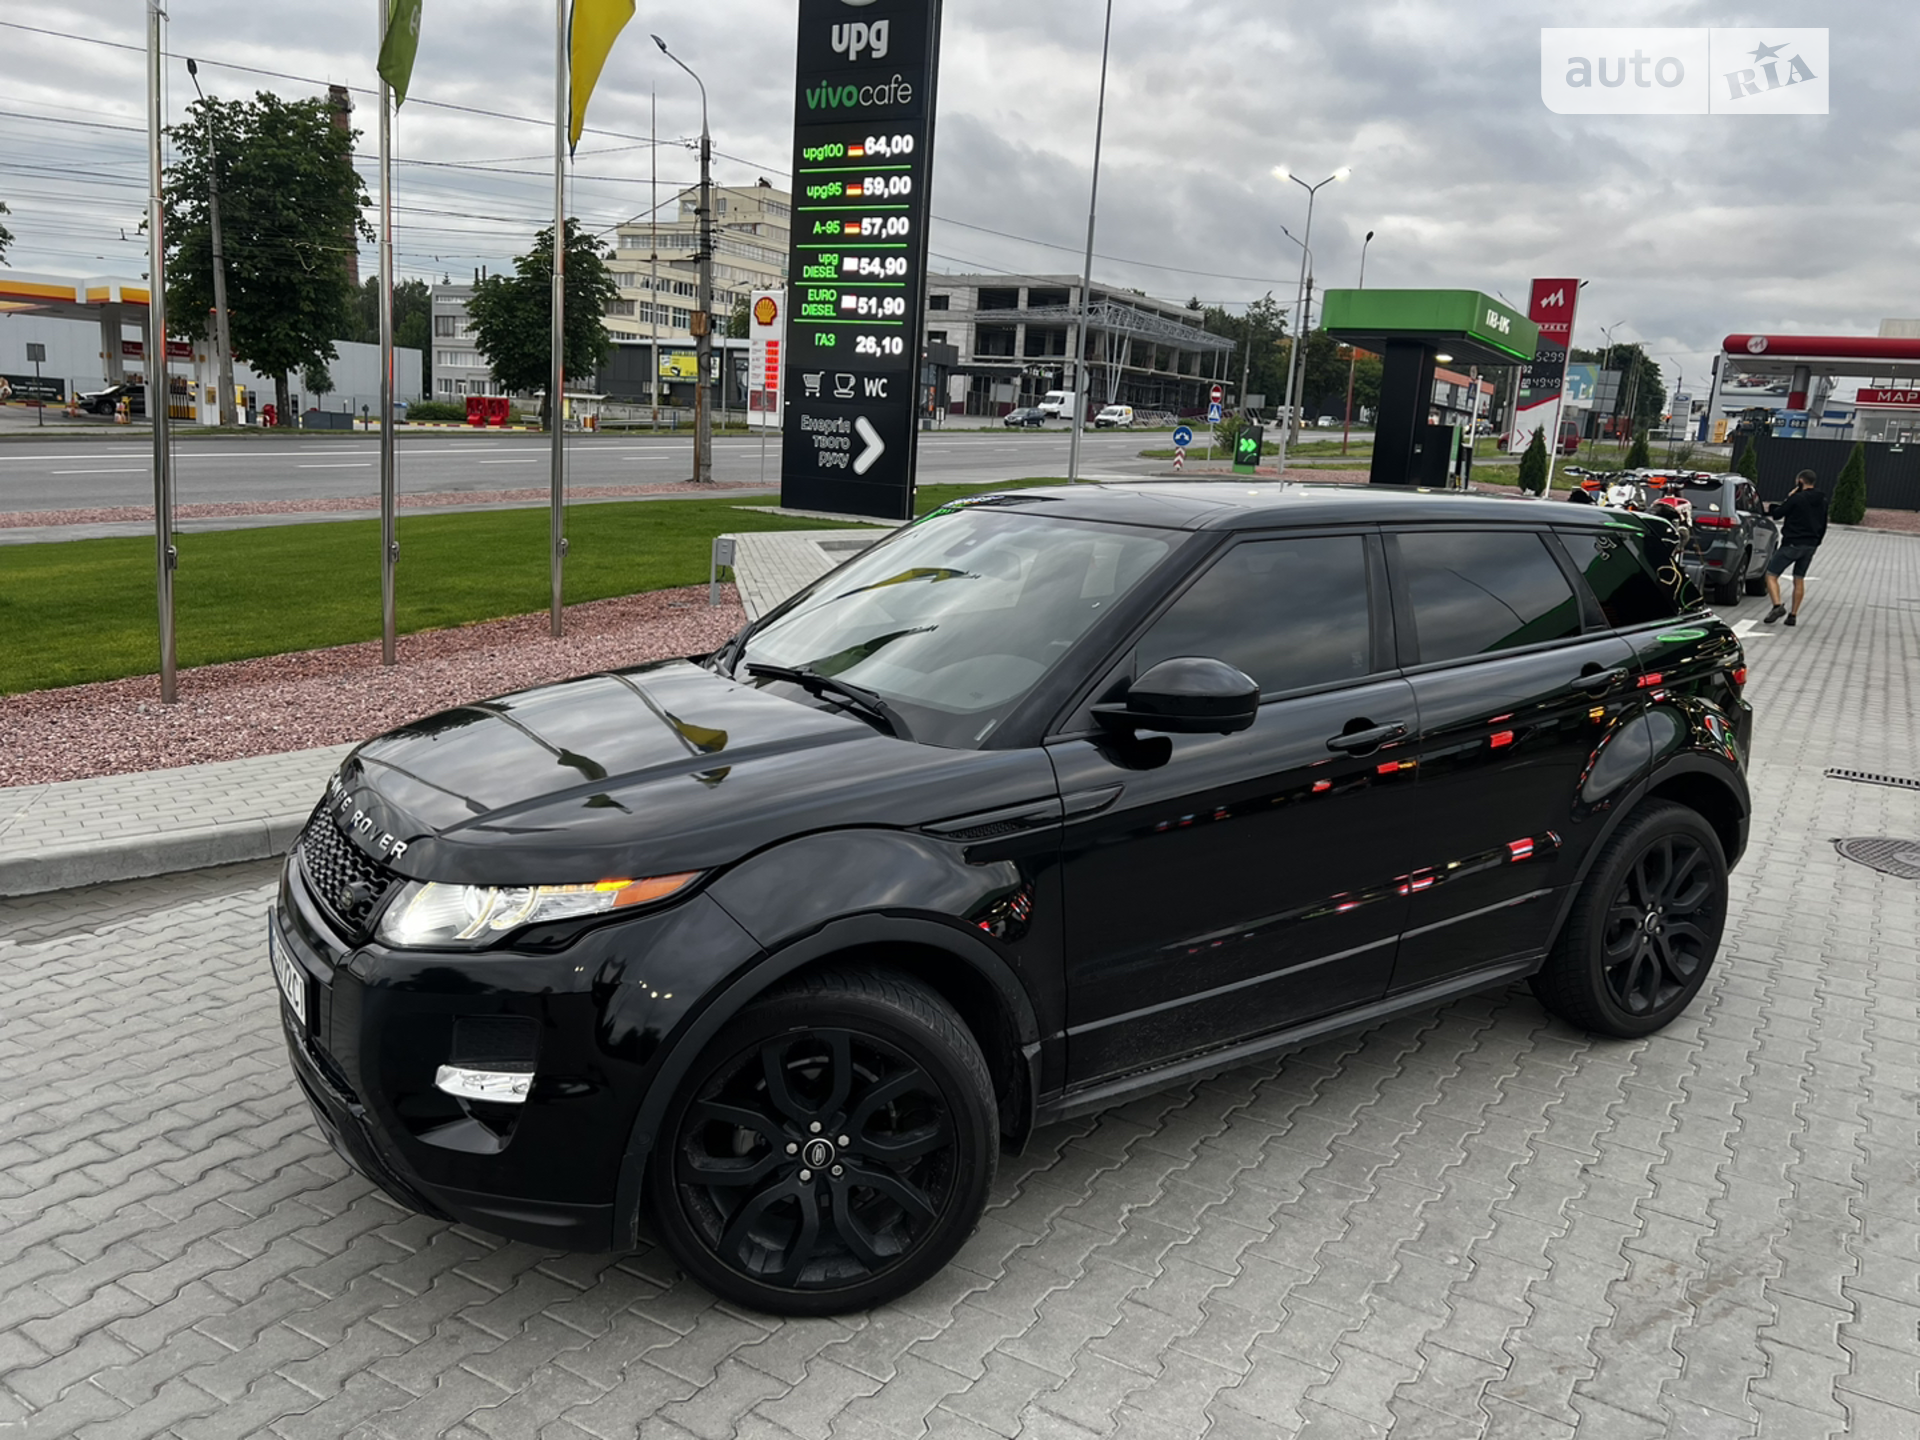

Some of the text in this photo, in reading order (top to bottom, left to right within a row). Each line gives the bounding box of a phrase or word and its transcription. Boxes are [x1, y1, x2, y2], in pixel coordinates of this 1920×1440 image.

[831, 19, 890, 61] upg
[803, 134, 914, 161] upg100 64,00
[807, 175, 912, 199] upg95 59,00
[860, 217, 910, 239] 57,00
[803, 256, 907, 279] DIESEL 54,90
[818, 253, 839, 266] upg
[807, 288, 838, 302] EURO
[801, 296, 905, 319] DIESEL 51,90
[815, 332, 836, 346] ГАЗ
[864, 377, 888, 398] WC
[801, 414, 851, 435] Енергія
[812, 435, 851, 450] твого
[819, 451, 850, 469] руху
[350, 808, 408, 860] ROVER
